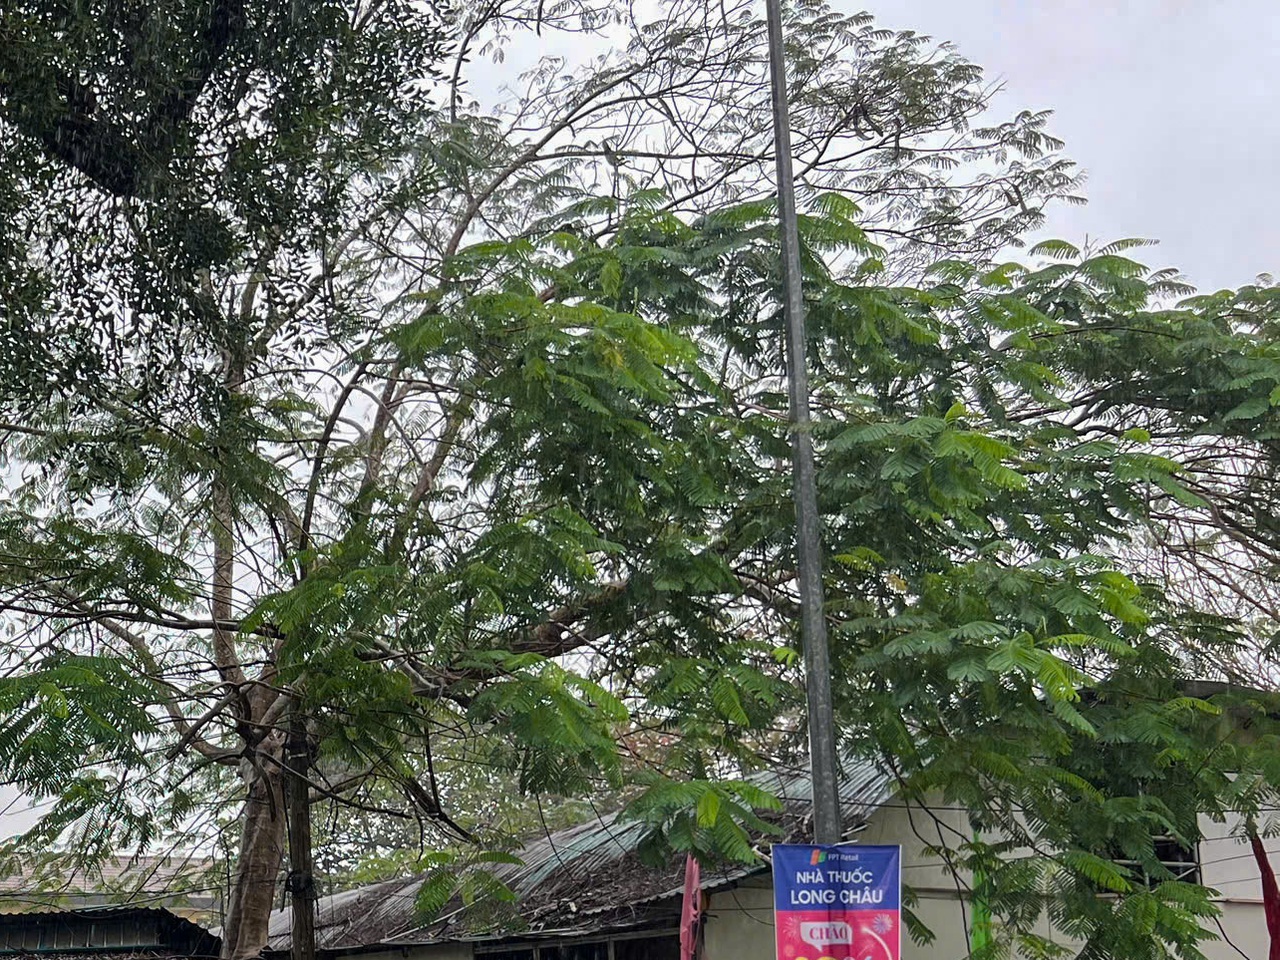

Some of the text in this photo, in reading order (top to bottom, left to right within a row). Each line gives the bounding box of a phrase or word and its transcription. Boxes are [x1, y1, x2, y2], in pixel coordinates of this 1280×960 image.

[796, 867, 873, 883] NHÀ THUỐC
[791, 886, 883, 904] LONG CHÂU
[809, 924, 848, 940] CHÀO
